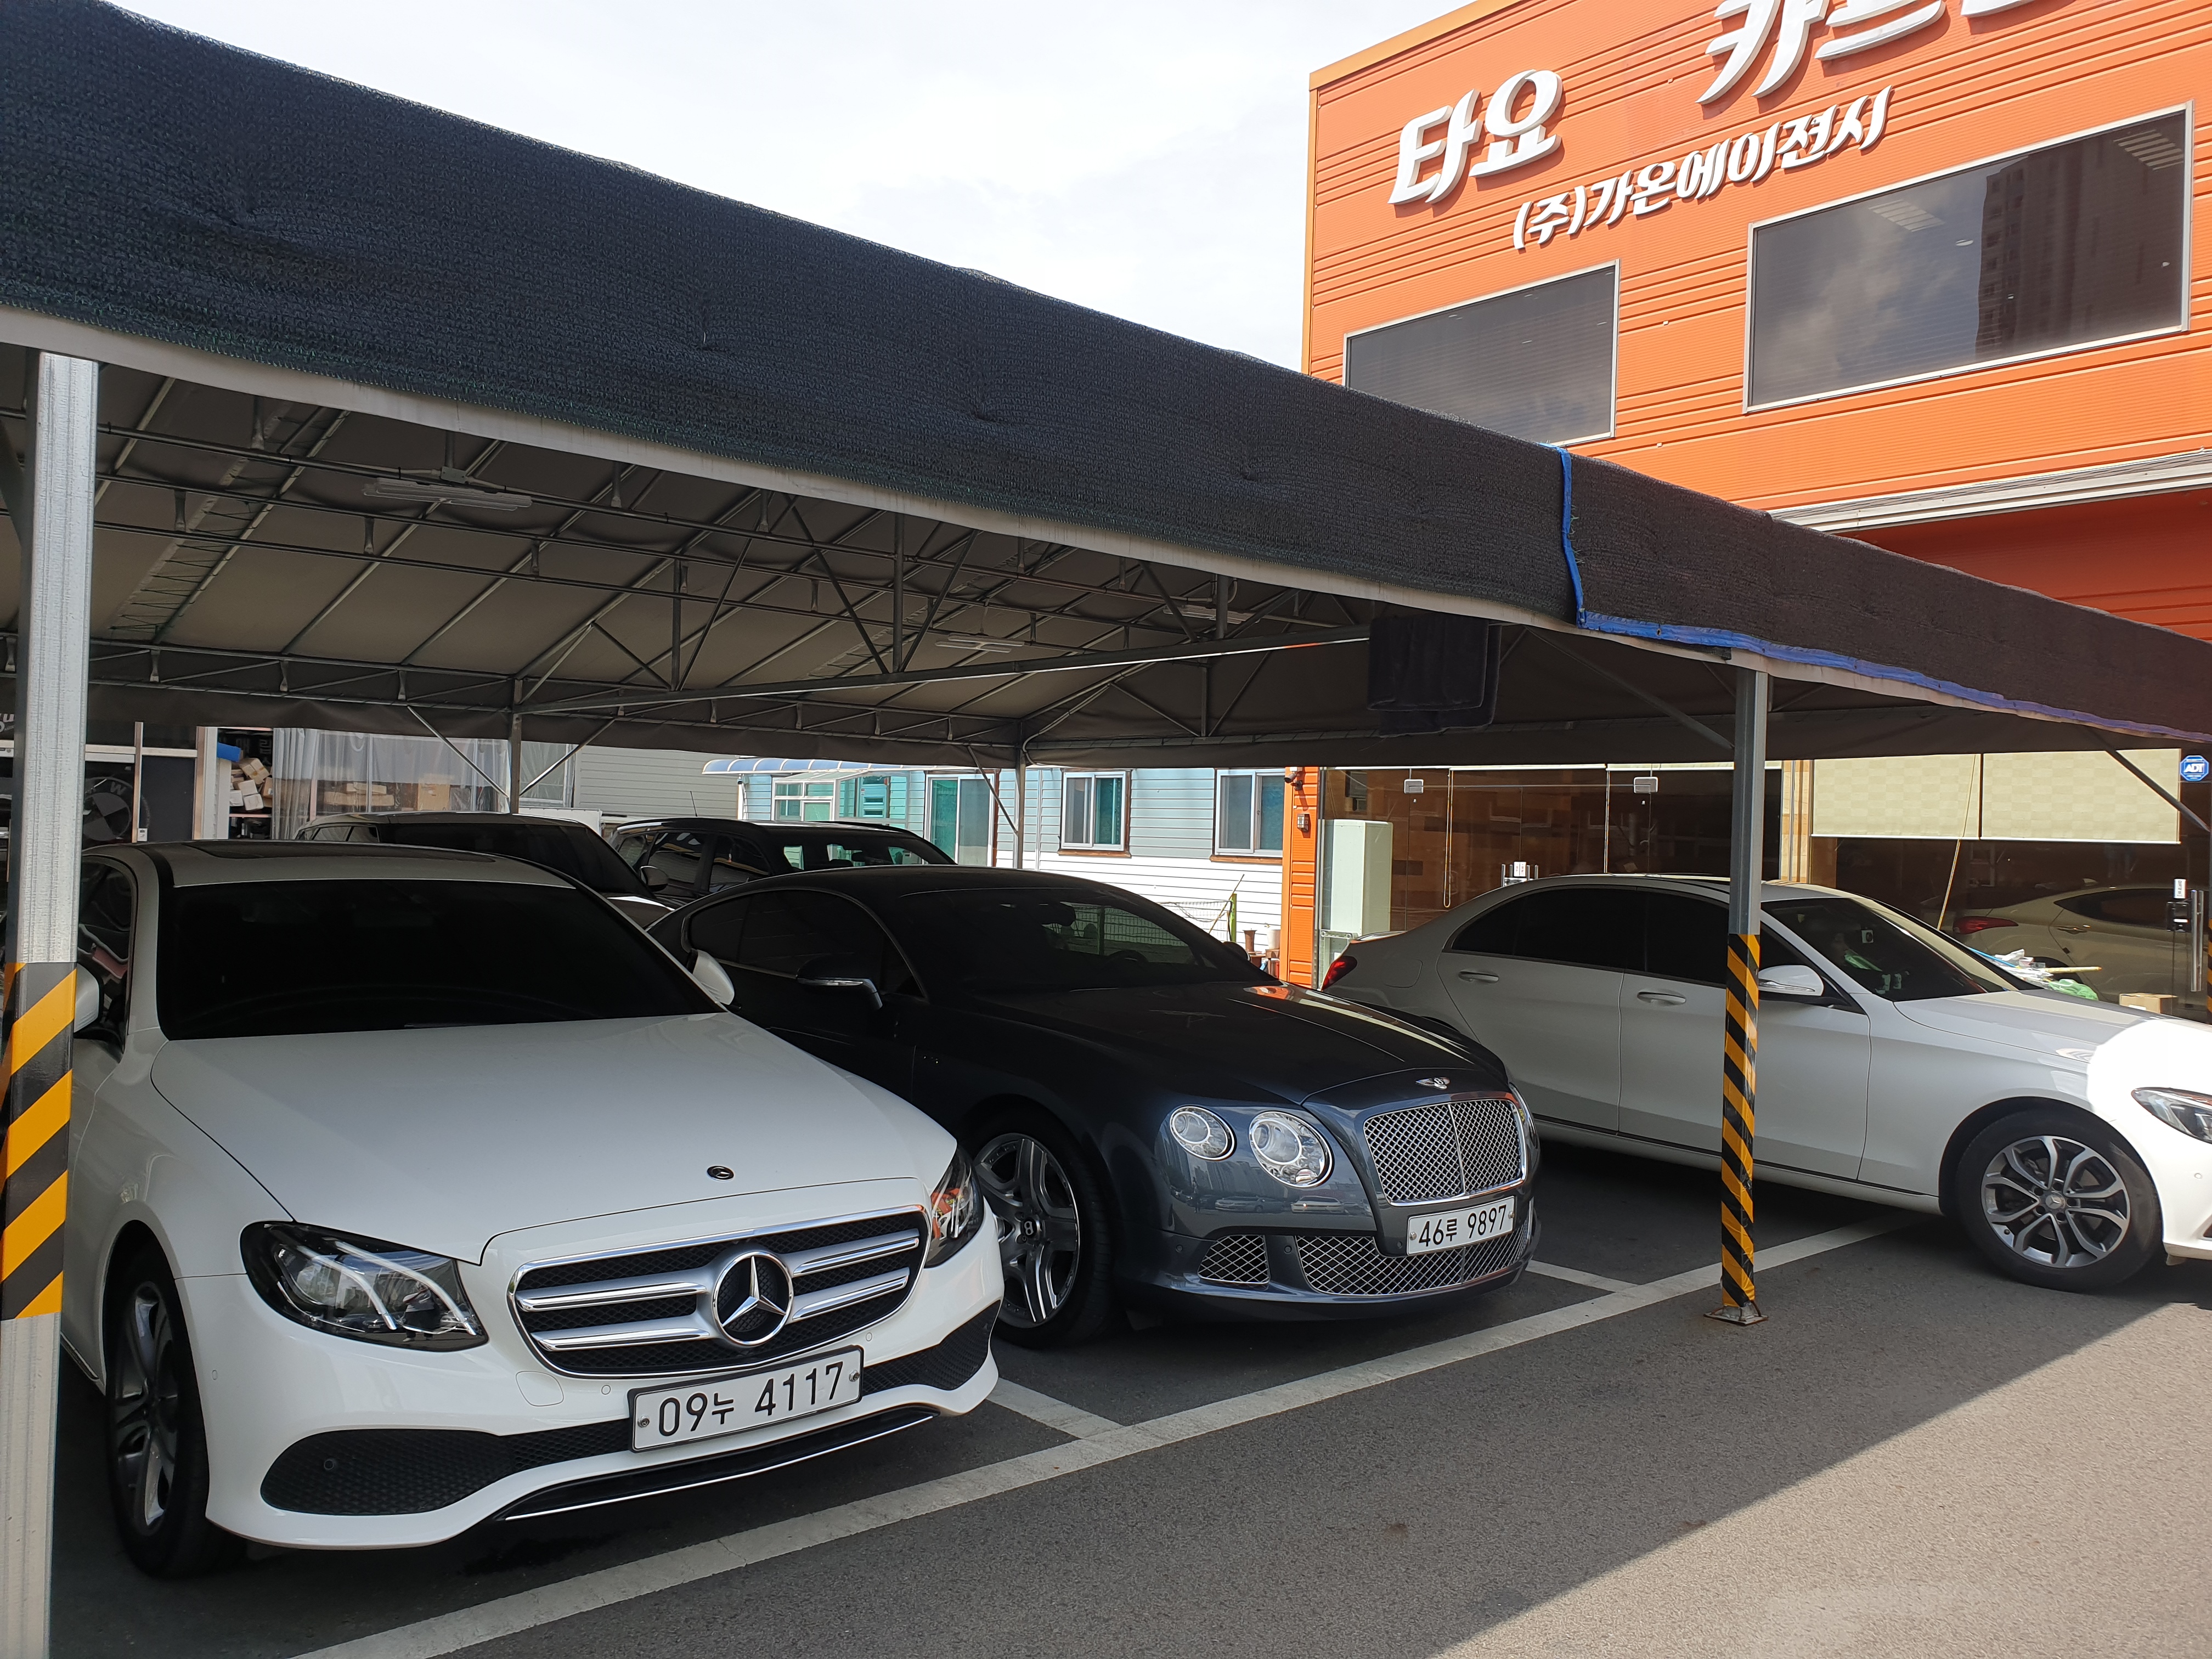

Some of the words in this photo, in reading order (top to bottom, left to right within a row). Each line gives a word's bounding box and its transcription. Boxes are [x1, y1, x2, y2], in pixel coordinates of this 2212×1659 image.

[1388, 69, 1562, 206] 타요
[2183, 763, 2205, 773] ADT
[1419, 1217, 1457, 1247] 46루
[1468, 1204, 1506, 1239] 9897
[658, 1392, 734, 1437] 09누
[754, 1361, 844, 1416] 4117
